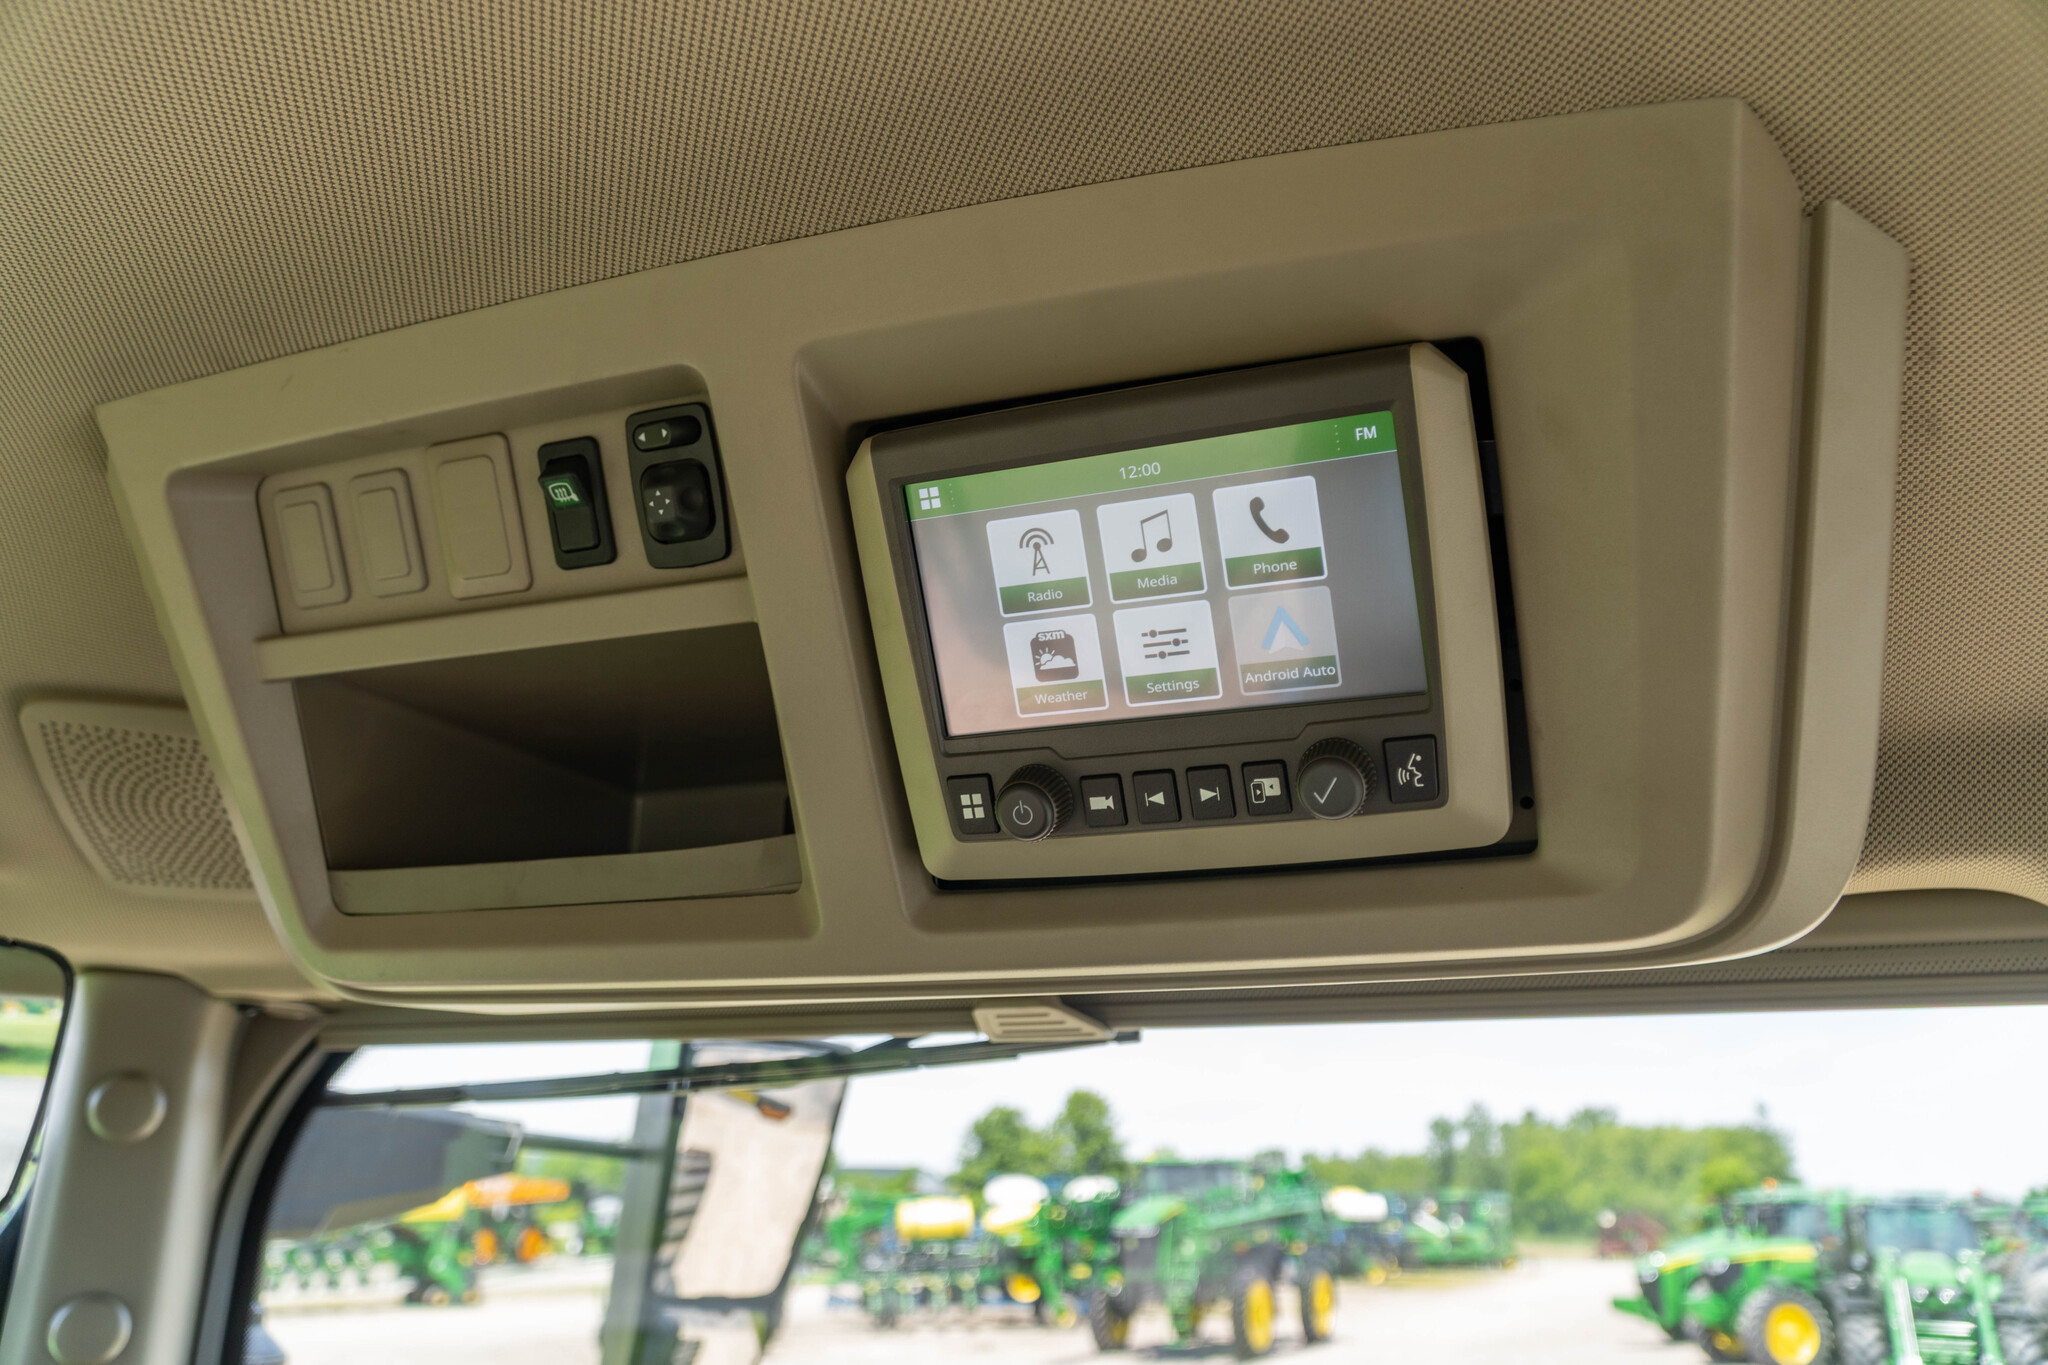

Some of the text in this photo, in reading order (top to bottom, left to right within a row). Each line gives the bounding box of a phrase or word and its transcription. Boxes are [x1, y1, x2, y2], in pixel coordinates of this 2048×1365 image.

[1355, 425, 1378, 442] FM
[1119, 461, 1161, 480] 12:00
[1253, 558, 1297, 575] Phone
[1137, 572, 1178, 589] Media
[1027, 587, 1063, 603] Radio
[1038, 630, 1065, 641] sxm
[1245, 662, 1336, 683] Android Auto
[1146, 677, 1200, 696] Settings
[1034, 689, 1087, 705] Weather
